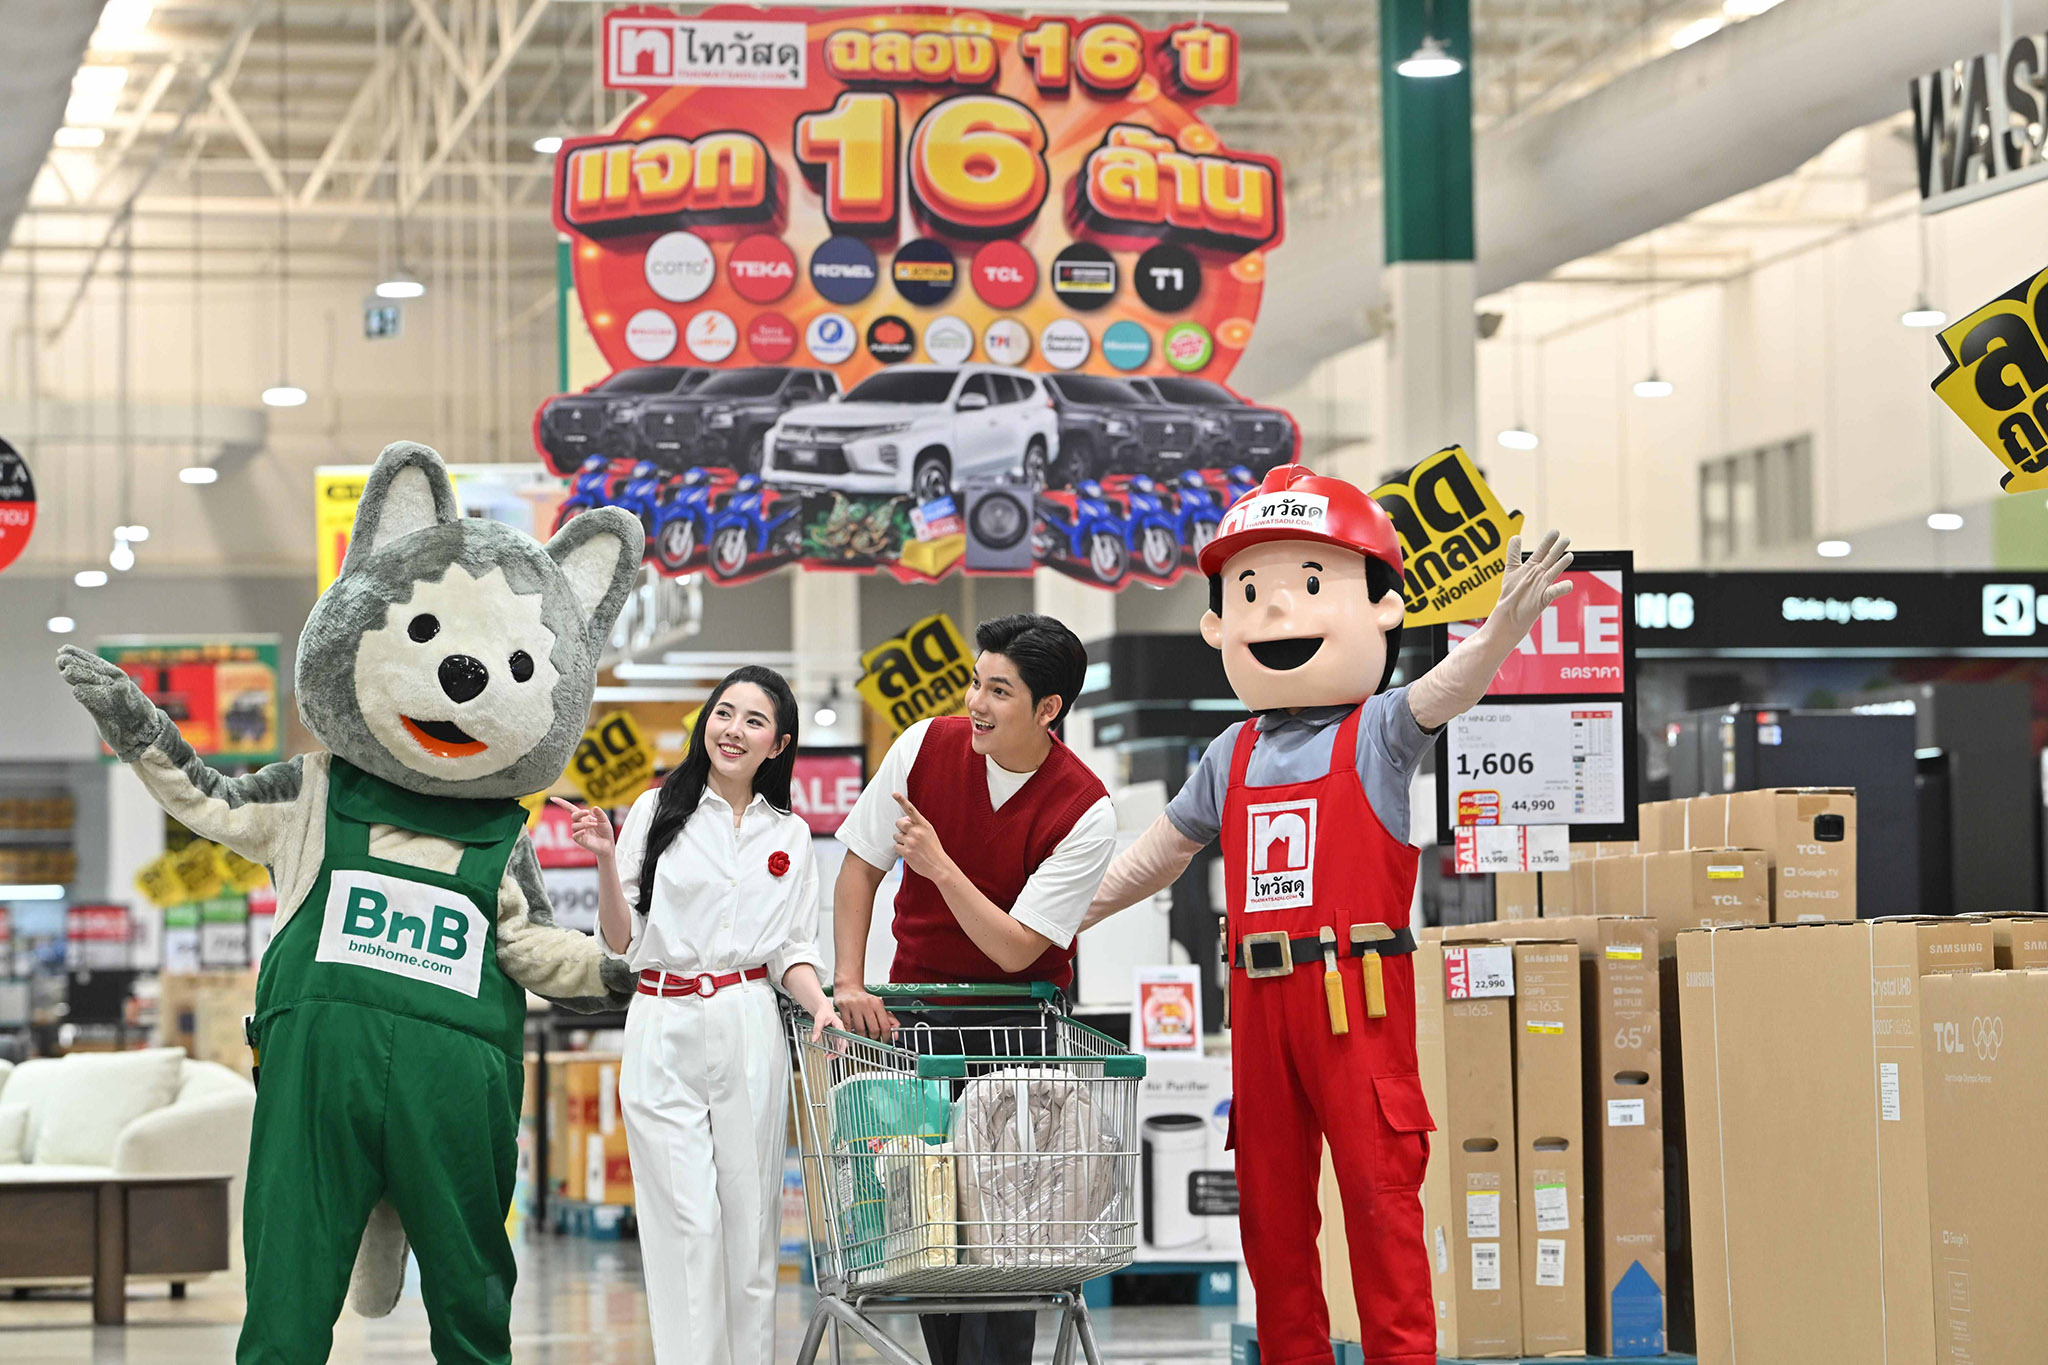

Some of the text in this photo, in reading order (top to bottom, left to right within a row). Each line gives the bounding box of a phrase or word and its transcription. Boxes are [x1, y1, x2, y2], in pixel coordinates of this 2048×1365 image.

[681, 26, 800, 79] ไทวัสดุ
[826, 28, 998, 86] ฉลอง
[1020, 22, 1145, 96] 16
[566, 90, 1277, 242] แจก 16 ล้าน
[730, 260, 792, 279] TEKA
[983, 266, 1024, 283] TCL
[869, 618, 961, 698] ลด
[1560, 665, 1621, 680] ลดราคา
[1457, 752, 1534, 780] 1,606
[1511, 799, 1555, 812] 44,990
[1796, 844, 1826, 855] TCL
[1252, 875, 1305, 898] ไทวัสดุ
[1712, 895, 1742, 905] TCL
[341, 886, 470, 961] BnB
[348, 939, 453, 976] bnbhome.com
[1929, 942, 1983, 954] SAMSUNG
[1450, 947, 1468, 999] SALE
[1475, 980, 1505, 988] 22,990
[1933, 1021, 1965, 1054] TCL
